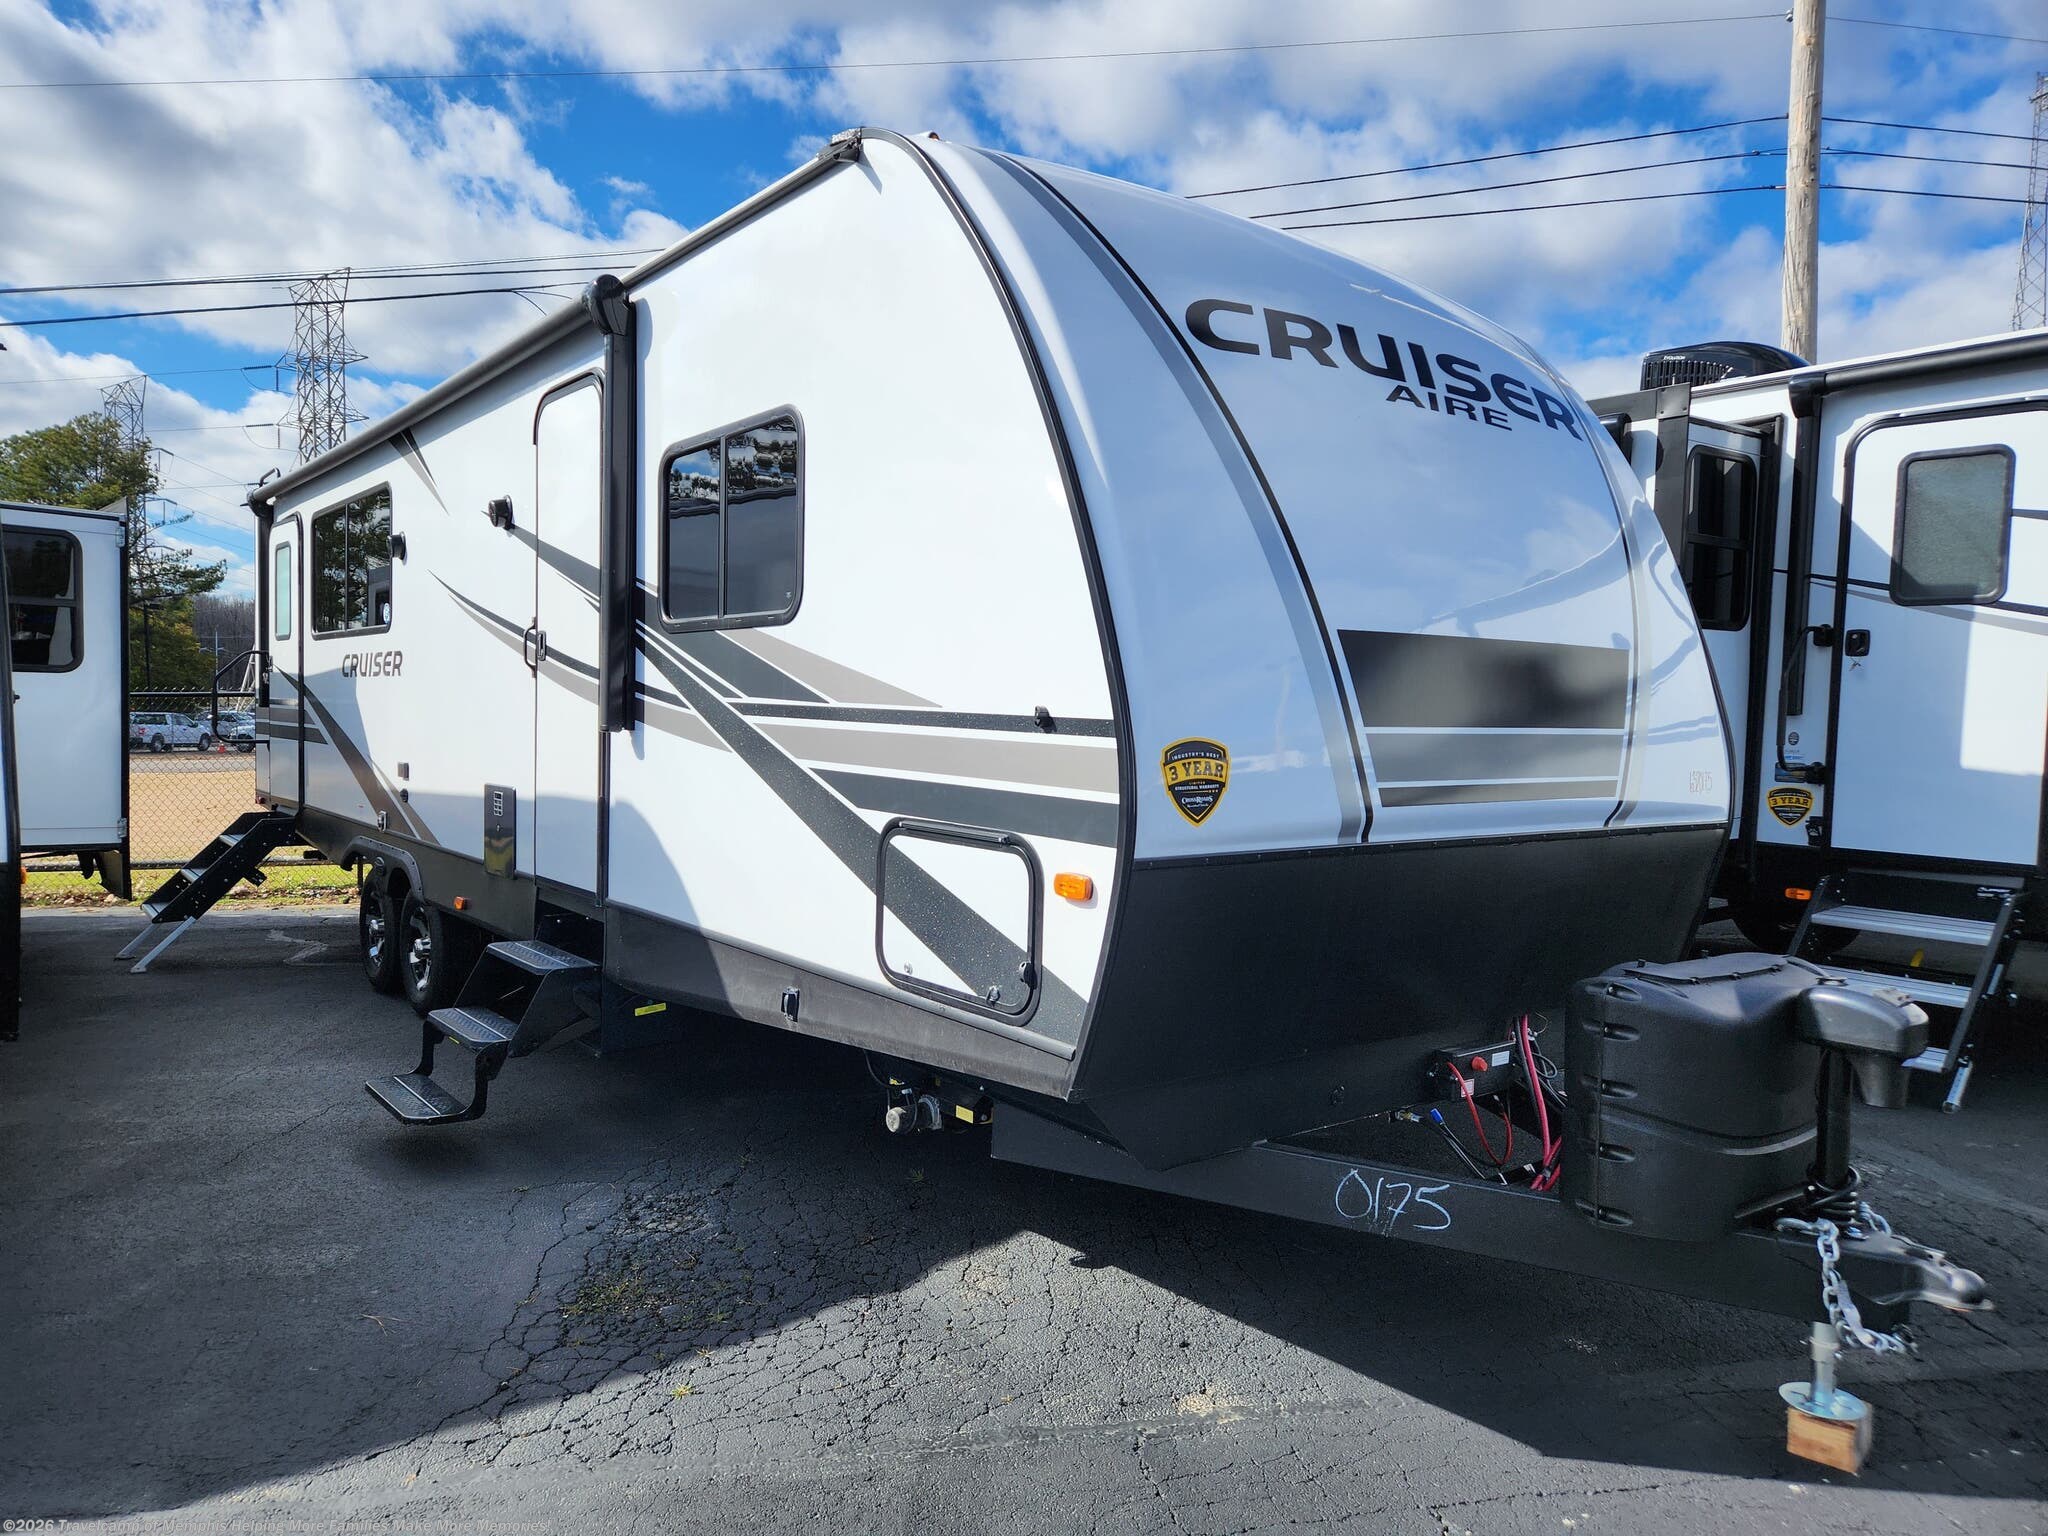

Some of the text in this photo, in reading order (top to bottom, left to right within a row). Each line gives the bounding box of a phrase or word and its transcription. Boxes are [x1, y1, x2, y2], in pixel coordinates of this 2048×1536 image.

[1185, 298, 1583, 441] CRUISER
[1386, 384, 1513, 431] AIRE
[342, 650, 403, 678] CRUISER
[1169, 760, 1224, 781] 3 YEAR
[1771, 797, 1809, 807] 3 YEAR
[1335, 1168, 1451, 1230] 0175
